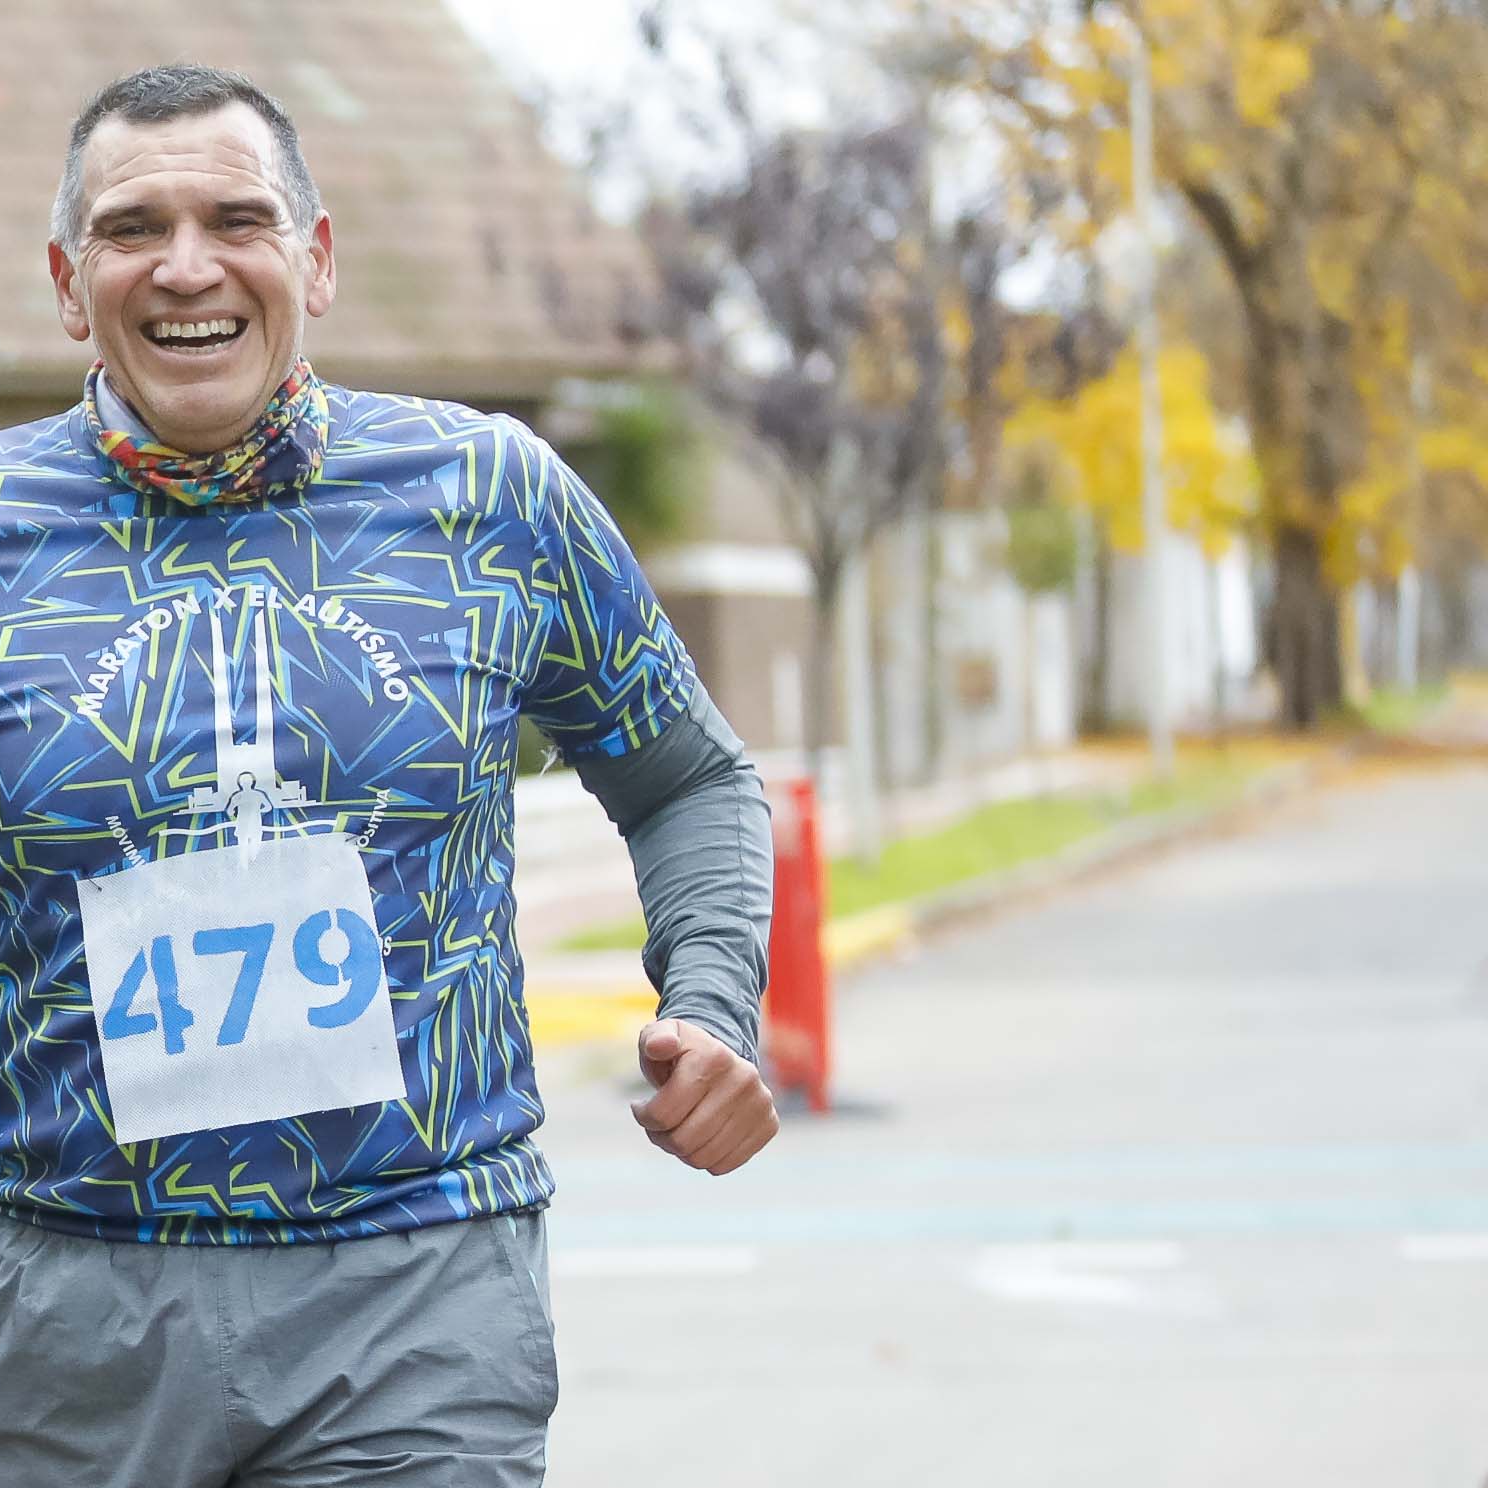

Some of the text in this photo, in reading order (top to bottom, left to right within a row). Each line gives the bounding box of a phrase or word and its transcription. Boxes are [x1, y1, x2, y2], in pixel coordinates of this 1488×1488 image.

[77, 585, 409, 719] MARATÓN X EL AUTISMO
[356, 789, 390, 848] OSITIVA
[102, 908, 382, 1056] 479
